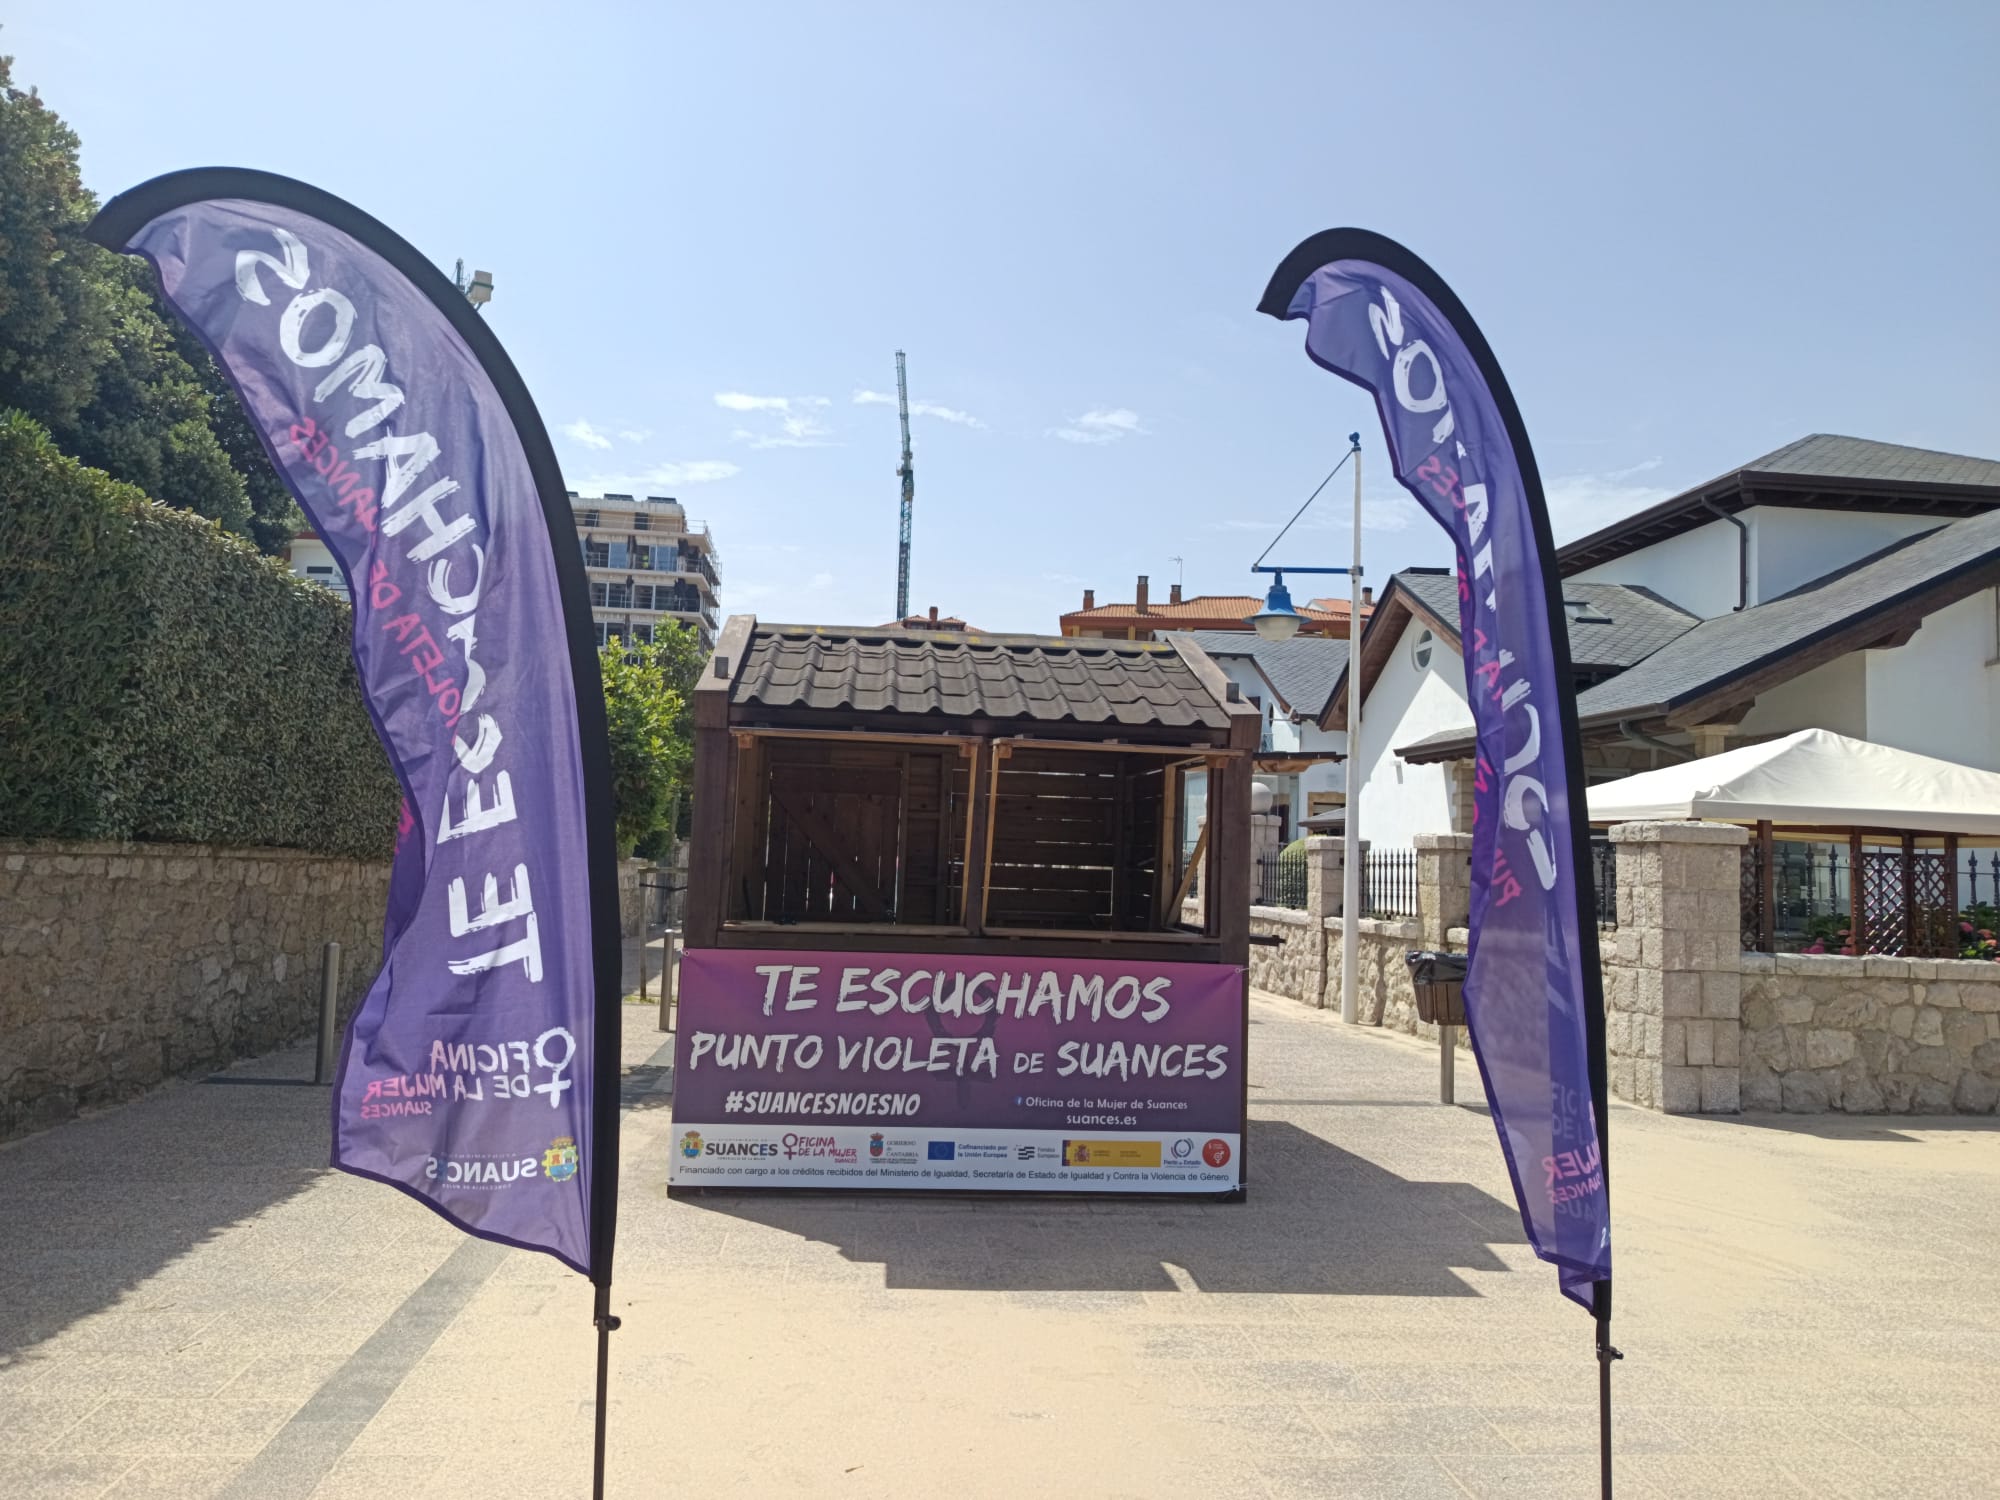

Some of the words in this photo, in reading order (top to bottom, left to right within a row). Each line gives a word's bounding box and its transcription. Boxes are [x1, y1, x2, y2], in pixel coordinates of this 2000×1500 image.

[755, 965, 820, 1016] TE
[836, 967, 1172, 1024] ESCUCHAMOS
[689, 1031, 823, 1073] PUNTO
[838, 1036, 999, 1078] VIOLETA
[1013, 1052, 1044, 1074] DE
[1057, 1041, 1228, 1082] SUANCES
[725, 1091, 921, 1116] #SUANCESNOESNO
[1026, 1096, 1064, 1108] Oficina
[1067, 1097, 1081, 1108] de
[1084, 1098, 1094, 1108] la
[1097, 1099, 1127, 1111] Mujer
[1130, 1099, 1143, 1109] de
[1147, 1099, 1188, 1110] Suances
[1066, 1114, 1137, 1125] suances.es
[705, 1143, 778, 1156] SUANCES
[812, 1148, 825, 1156] LA
[828, 1149, 857, 1158] MUJER
[679, 1166, 725, 1175] Financiado
[744, 1168, 768, 1177] cargo
[792, 1168, 824, 1176] créditos
[827, 1168, 863, 1177] recibidos
[865, 1168, 878, 1177] del
[880, 1168, 919, 1177] Ministerio
[921, 1169, 931, 1177] de
[934, 1169, 970, 1179] Igualdad,
[972, 1169, 1014, 1178] Secretaría
[1016, 1170, 1026, 1179] de
[1029, 1171, 1056, 1179] Estado
[1058, 1171, 1068, 1179] de
[1070, 1171, 1105, 1181] Igualdad
[1106, 1174, 1111, 1182] y
[1113, 1172, 1140, 1180] Contra
[1142, 1172, 1149, 1180] la
[1151, 1172, 1186, 1181] Violencia
[1188, 1172, 1198, 1181] de
[1200, 1173, 1229, 1181] Género
